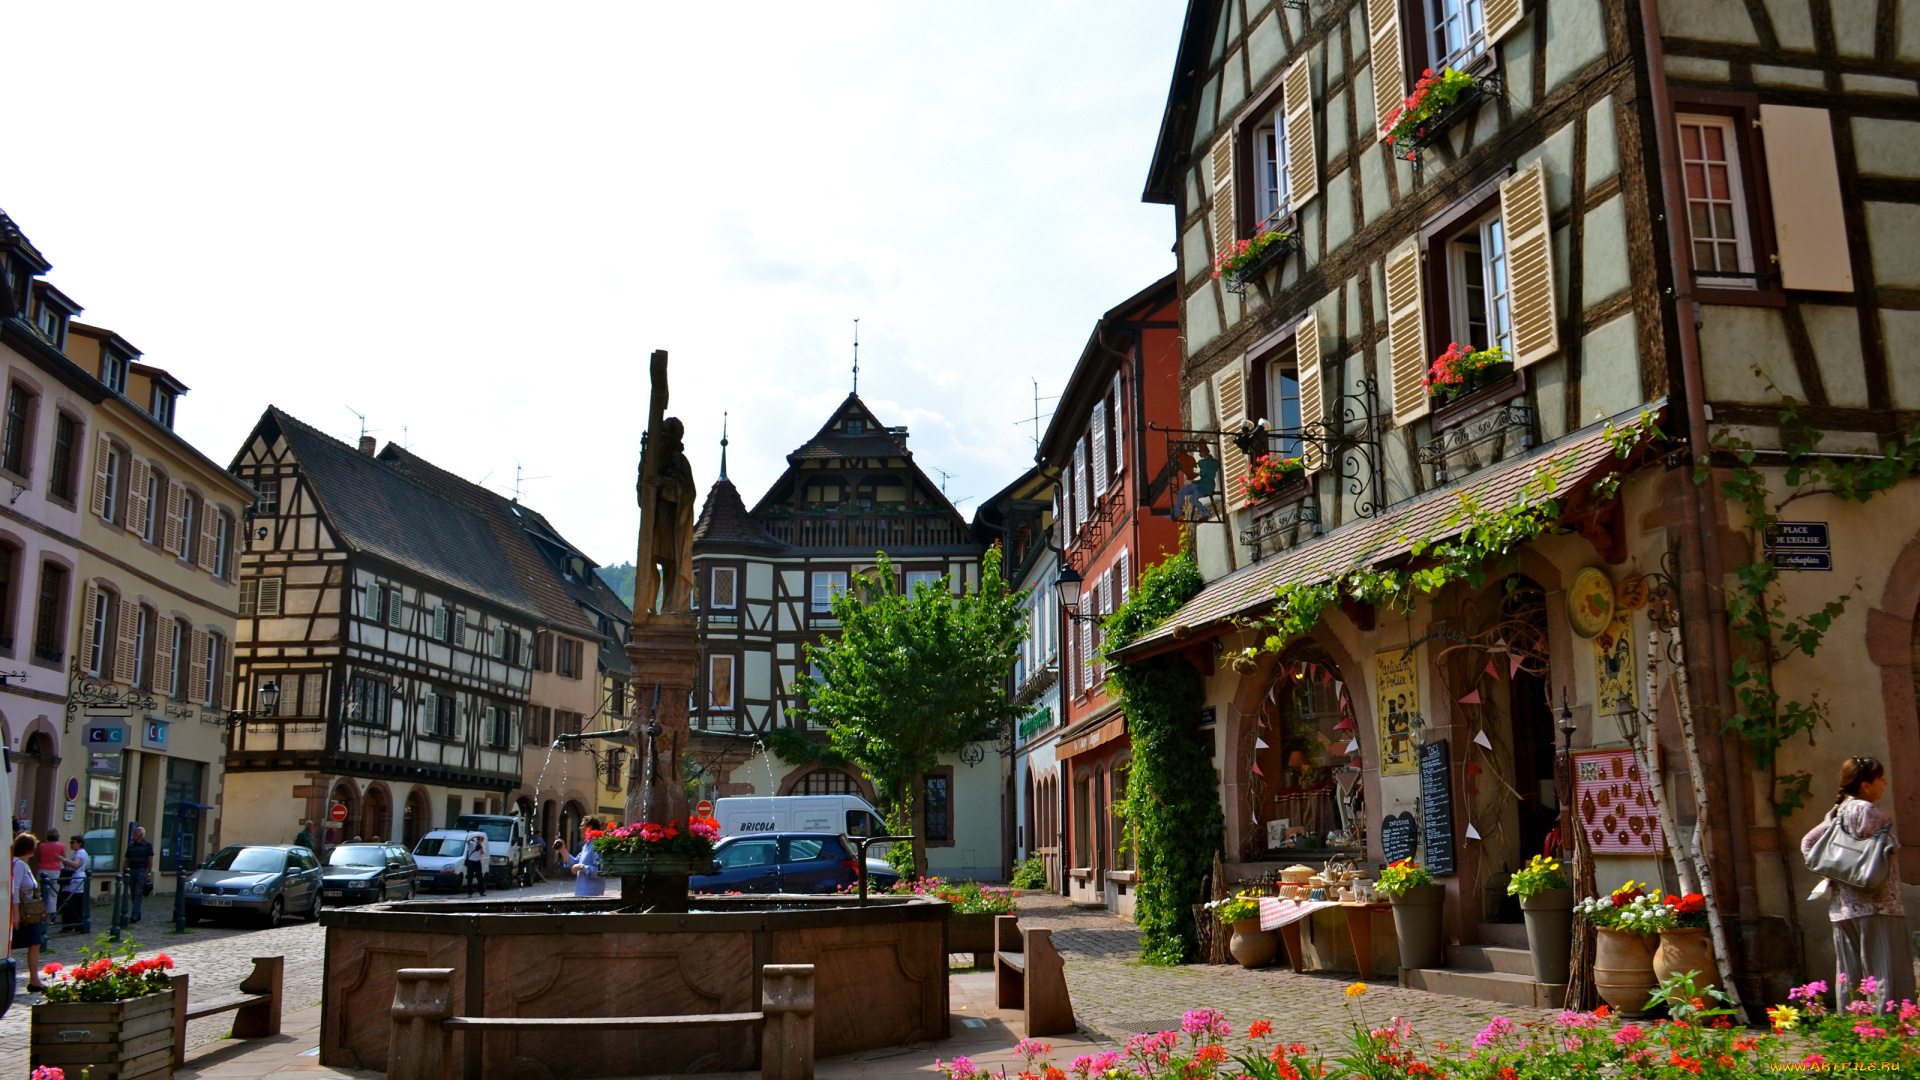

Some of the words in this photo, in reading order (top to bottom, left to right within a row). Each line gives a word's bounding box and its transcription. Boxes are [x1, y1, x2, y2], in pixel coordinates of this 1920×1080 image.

[1783, 526, 1808, 534] PLACE
[1786, 536, 1820, 544] L'EGLISE
[92, 730, 120, 740] CIC
[149, 724, 164, 740] CIC
[740, 822, 775, 832] BRICOLA
